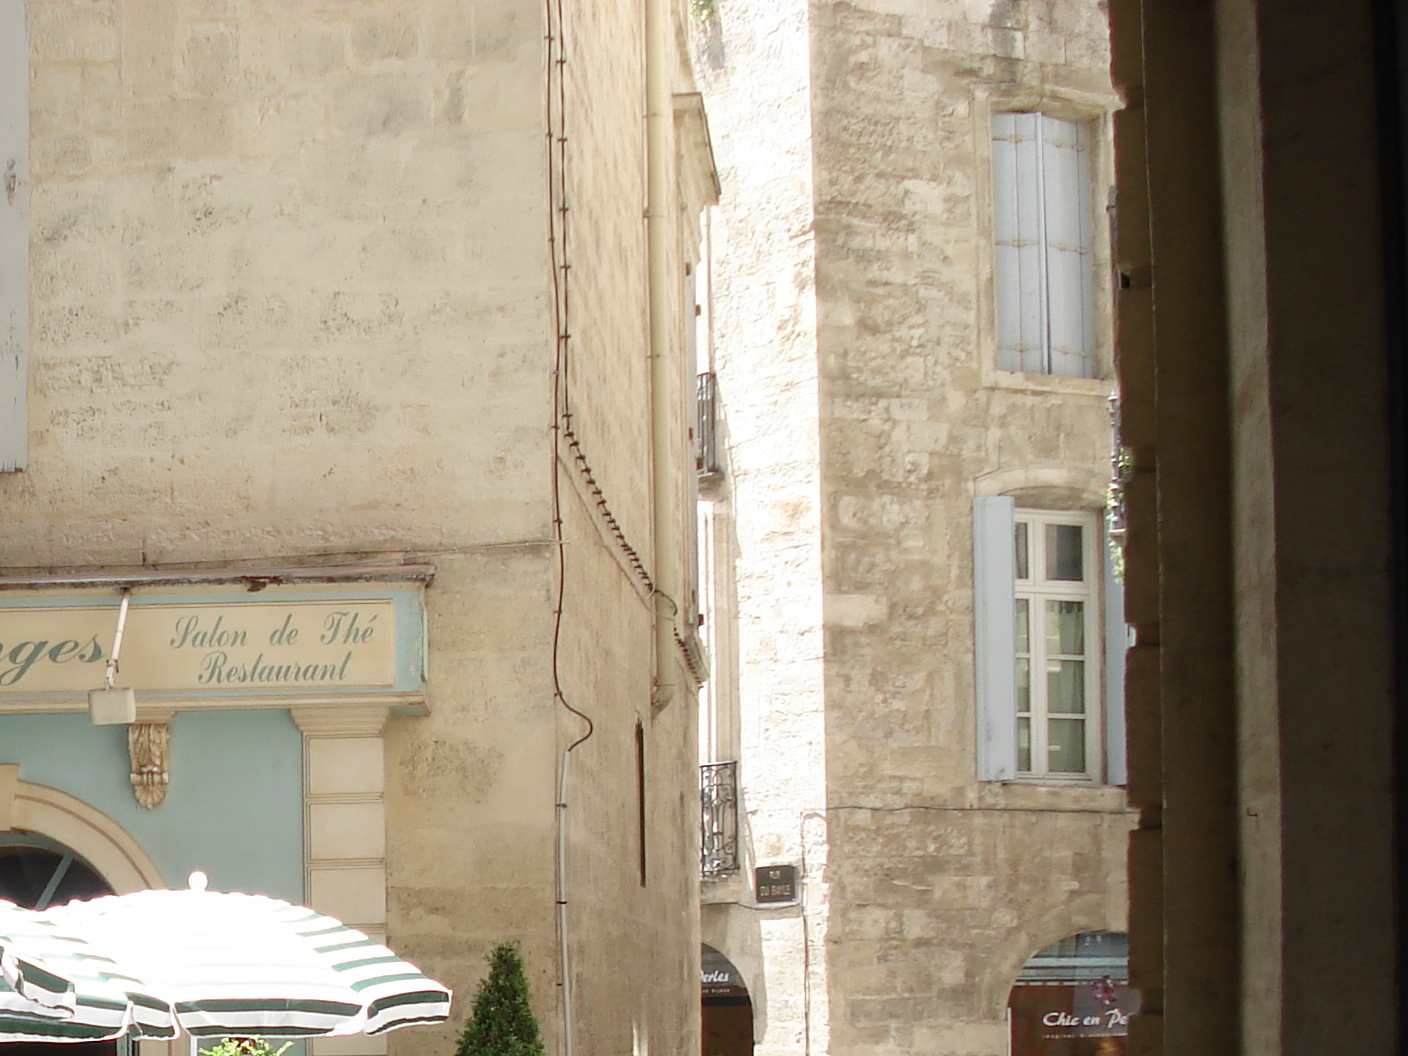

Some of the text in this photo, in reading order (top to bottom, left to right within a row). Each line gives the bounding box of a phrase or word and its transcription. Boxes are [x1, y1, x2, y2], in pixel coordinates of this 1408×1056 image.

[169, 611, 379, 649] Salon de Thé
[198, 650, 353, 684] Restaurant
[1042, 1011, 1080, 1027] Chic
[1082, 1015, 1101, 1026] en
